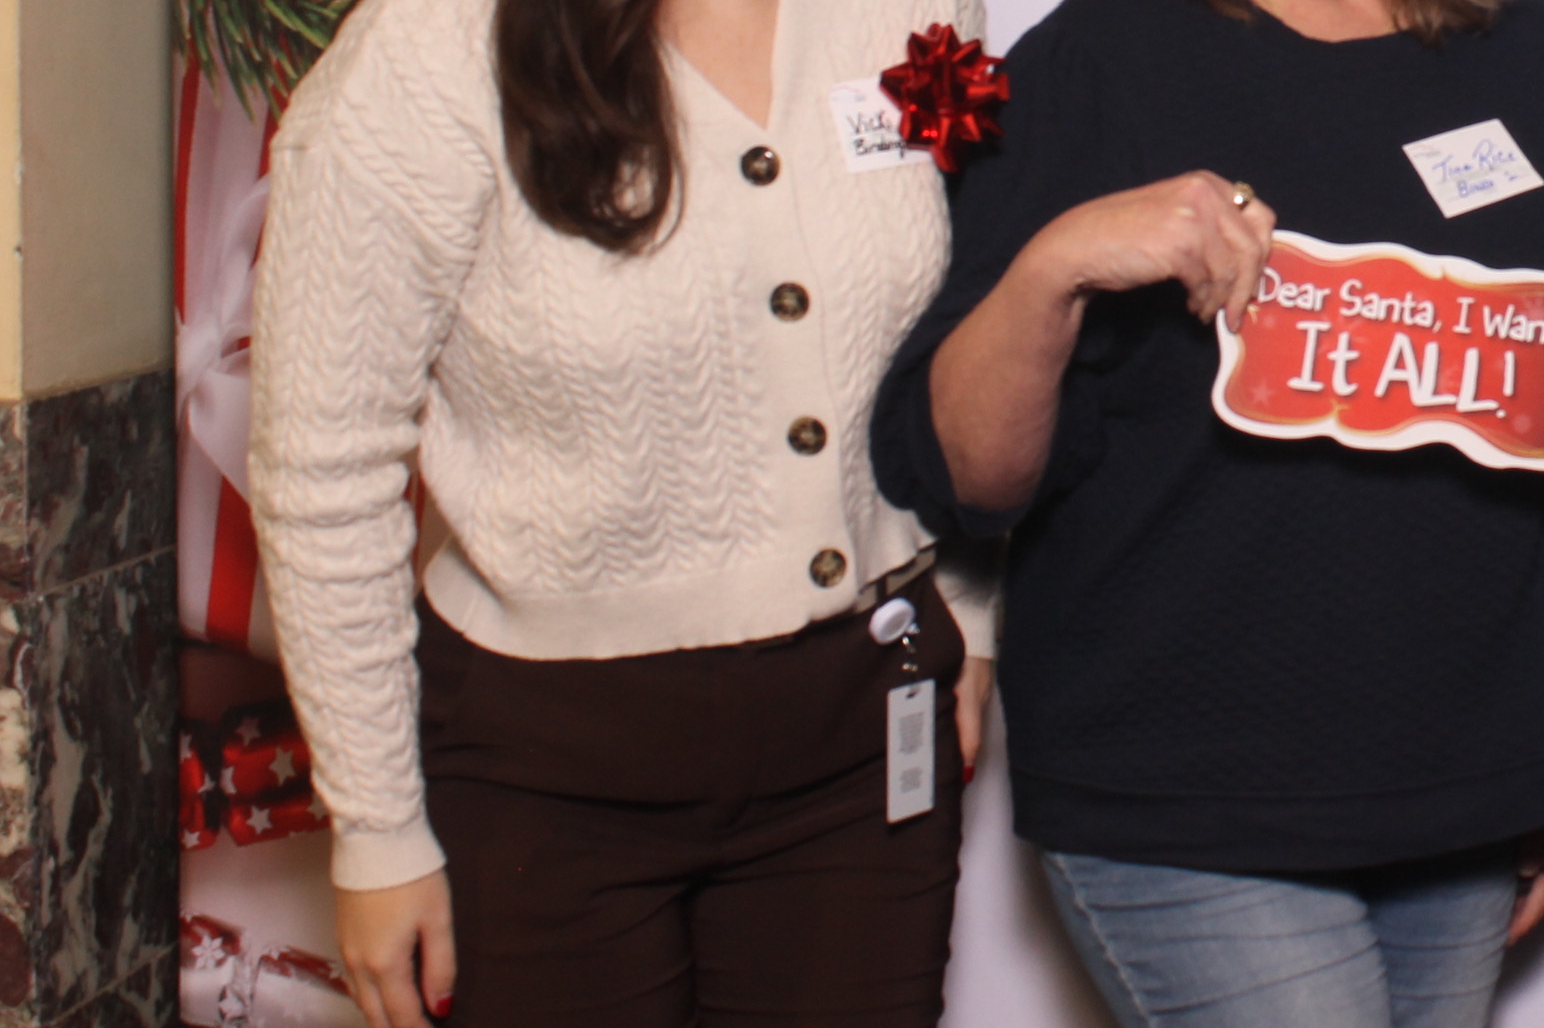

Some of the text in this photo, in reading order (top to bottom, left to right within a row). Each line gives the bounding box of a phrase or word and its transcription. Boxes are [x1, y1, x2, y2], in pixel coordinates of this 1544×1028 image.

[1257, 266, 1332, 312] Dear
[1339, 278, 1442, 332] Santa,
[1453, 296, 1476, 335] I
[1286, 320, 1515, 419] It ALL!
